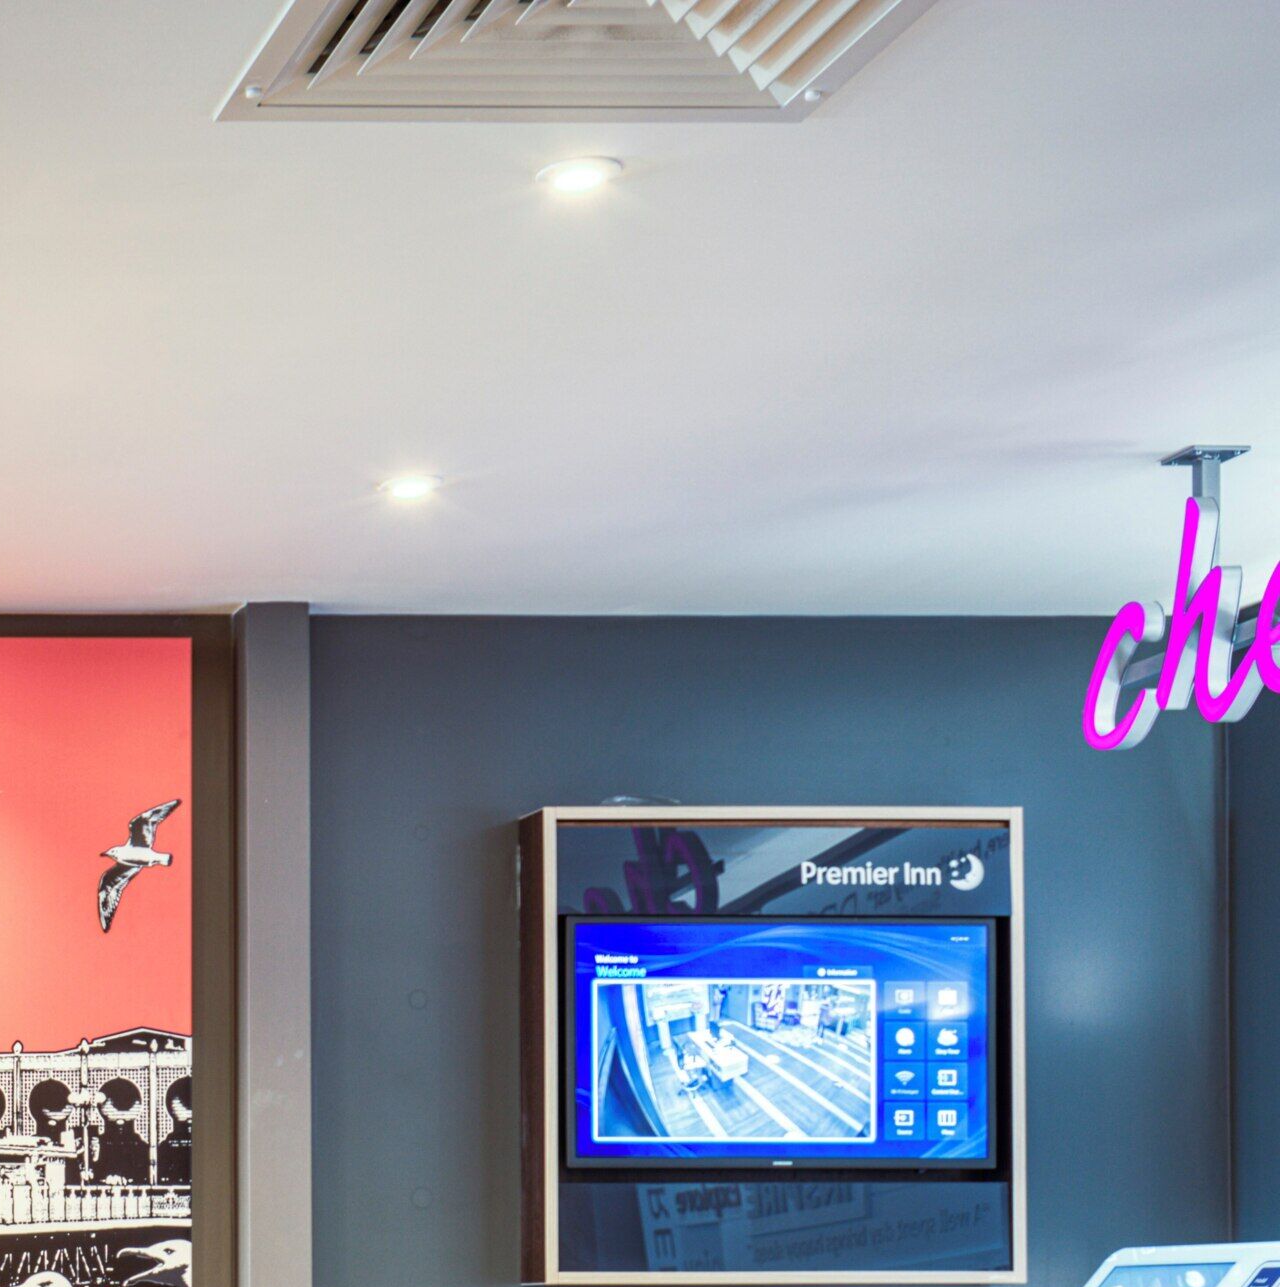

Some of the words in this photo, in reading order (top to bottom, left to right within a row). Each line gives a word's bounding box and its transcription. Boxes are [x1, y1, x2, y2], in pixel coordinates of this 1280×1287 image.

[800, 861, 899, 886] Premier
[903, 861, 942, 886] Inn
[595, 965, 646, 977] Welcome
